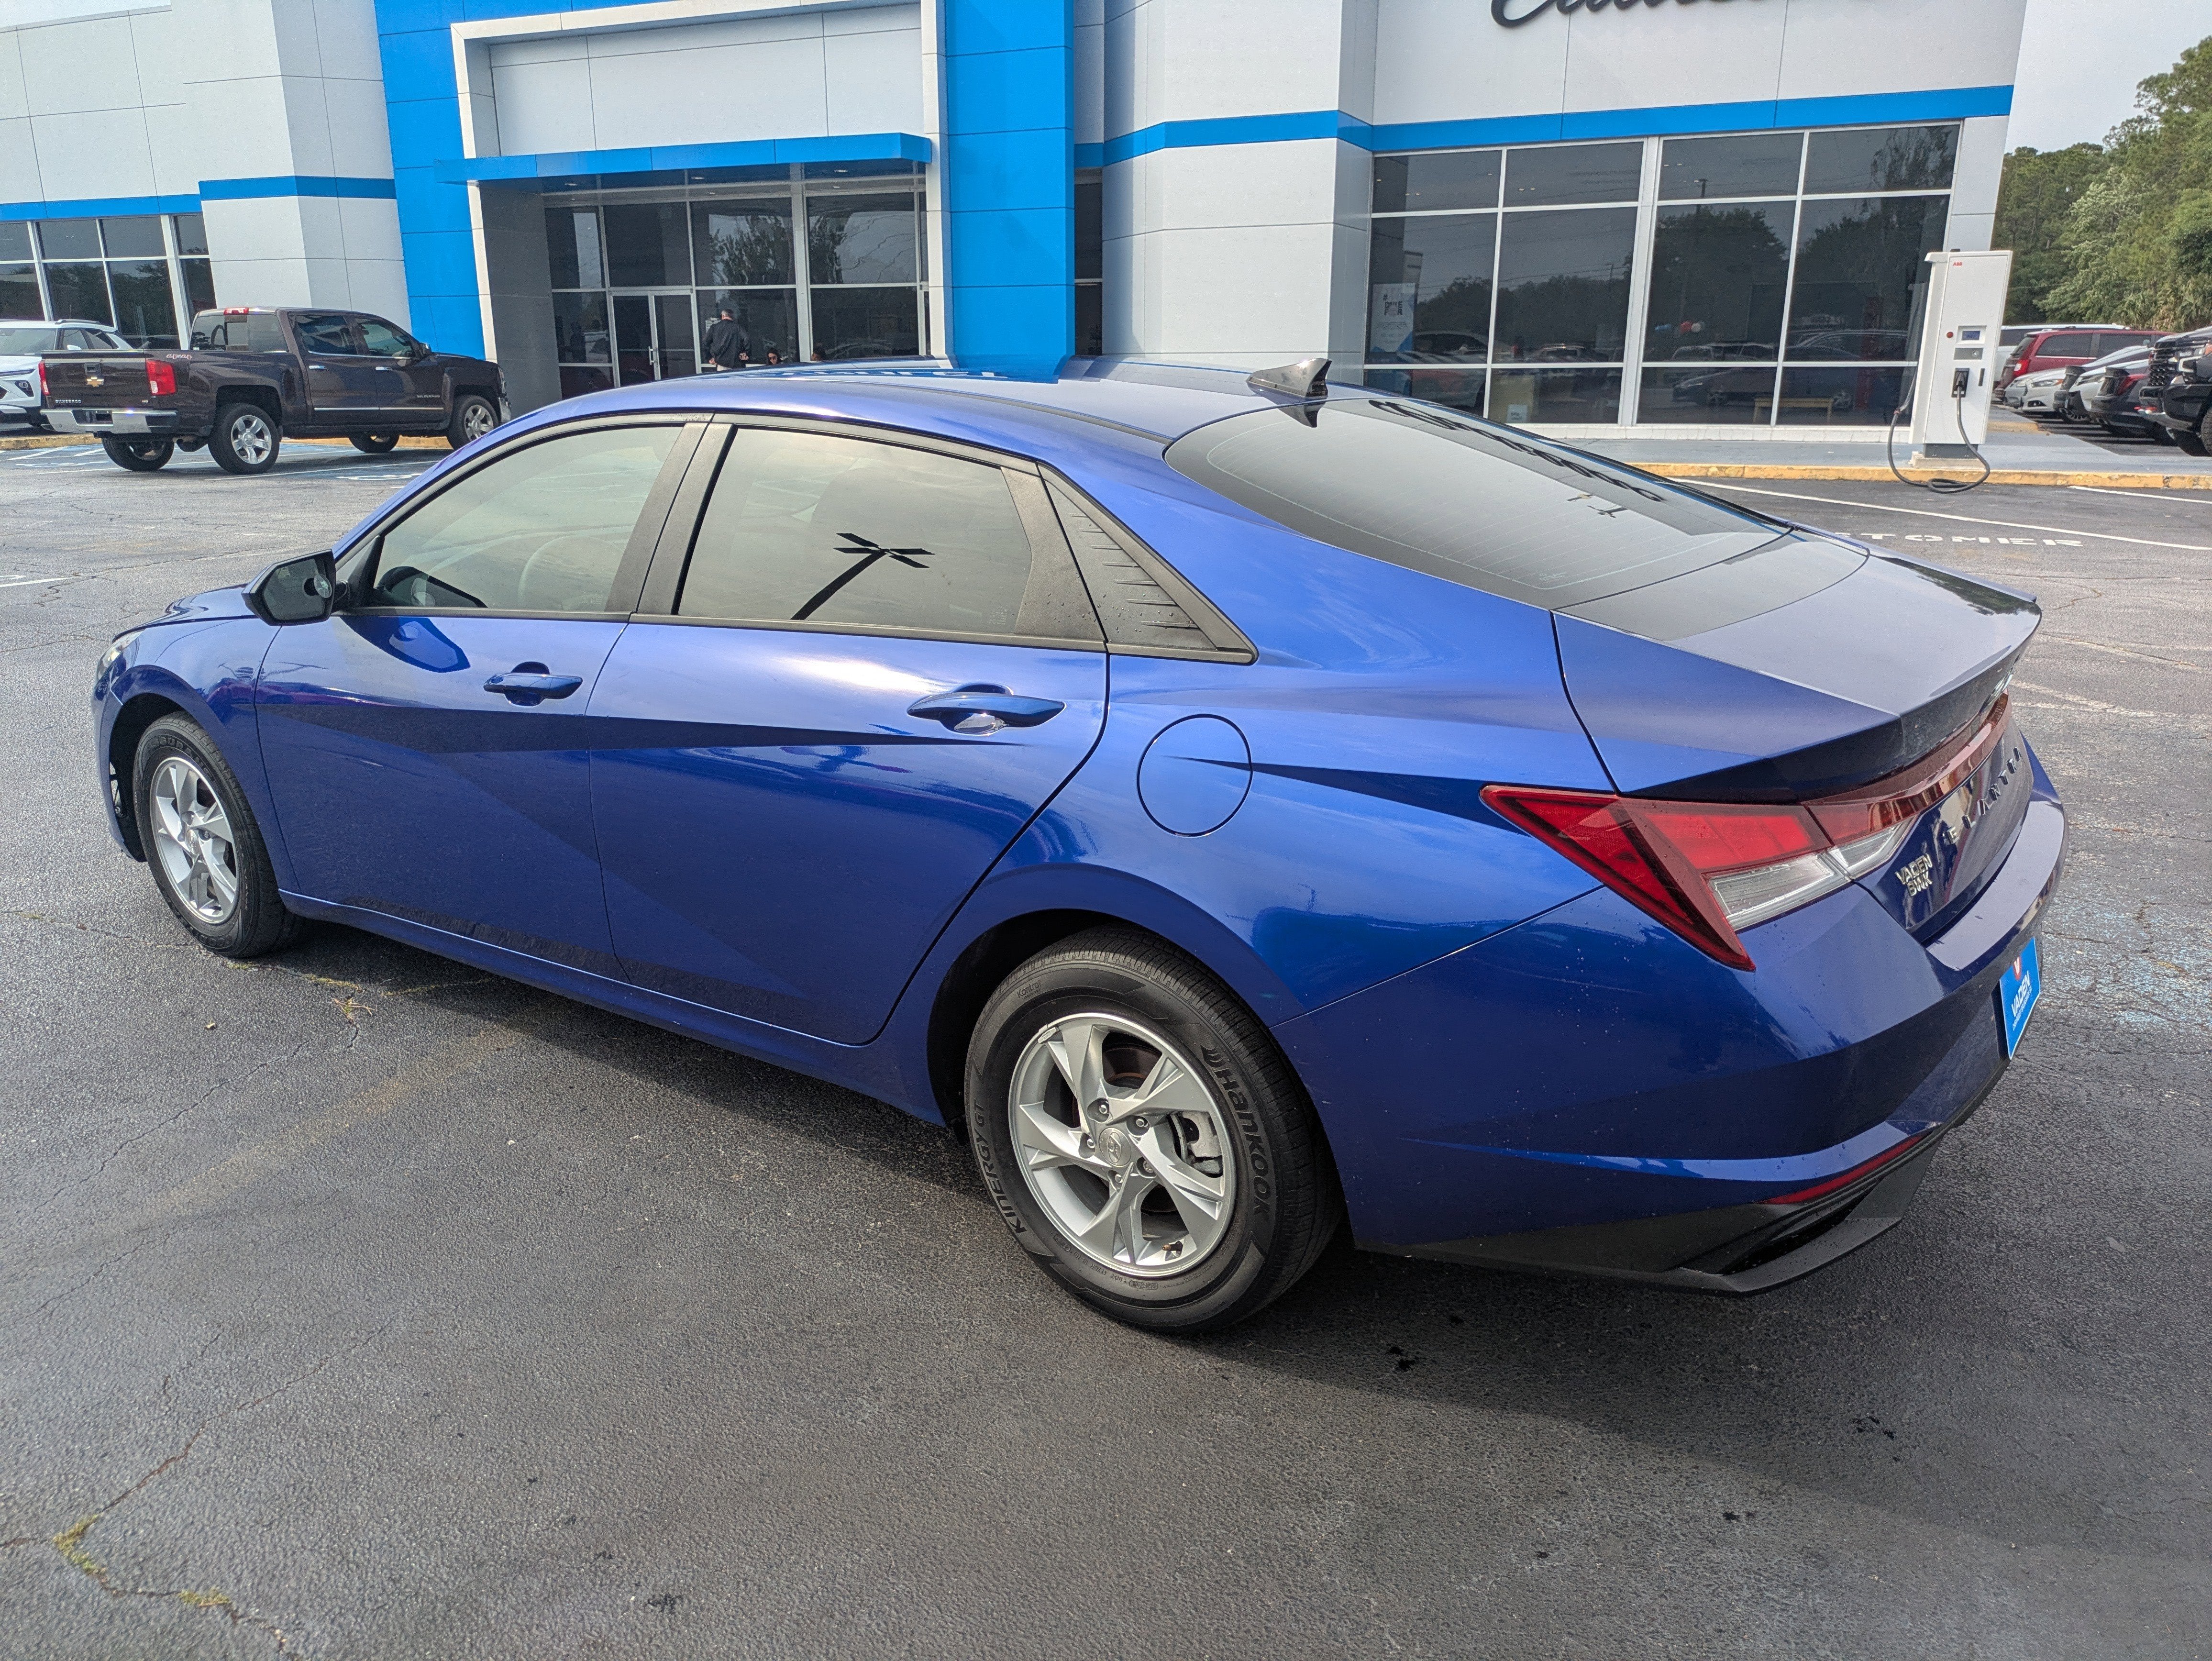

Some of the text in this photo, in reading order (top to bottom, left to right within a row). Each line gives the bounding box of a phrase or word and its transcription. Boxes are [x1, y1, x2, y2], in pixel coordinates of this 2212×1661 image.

[1895, 853, 1933, 885] VADEN
[1907, 870, 1933, 897] BWK
[2011, 970, 2031, 1018] VADEN
[1214, 1068, 1271, 1215] Hankook
[974, 1098, 1027, 1234] KINERGY GT
